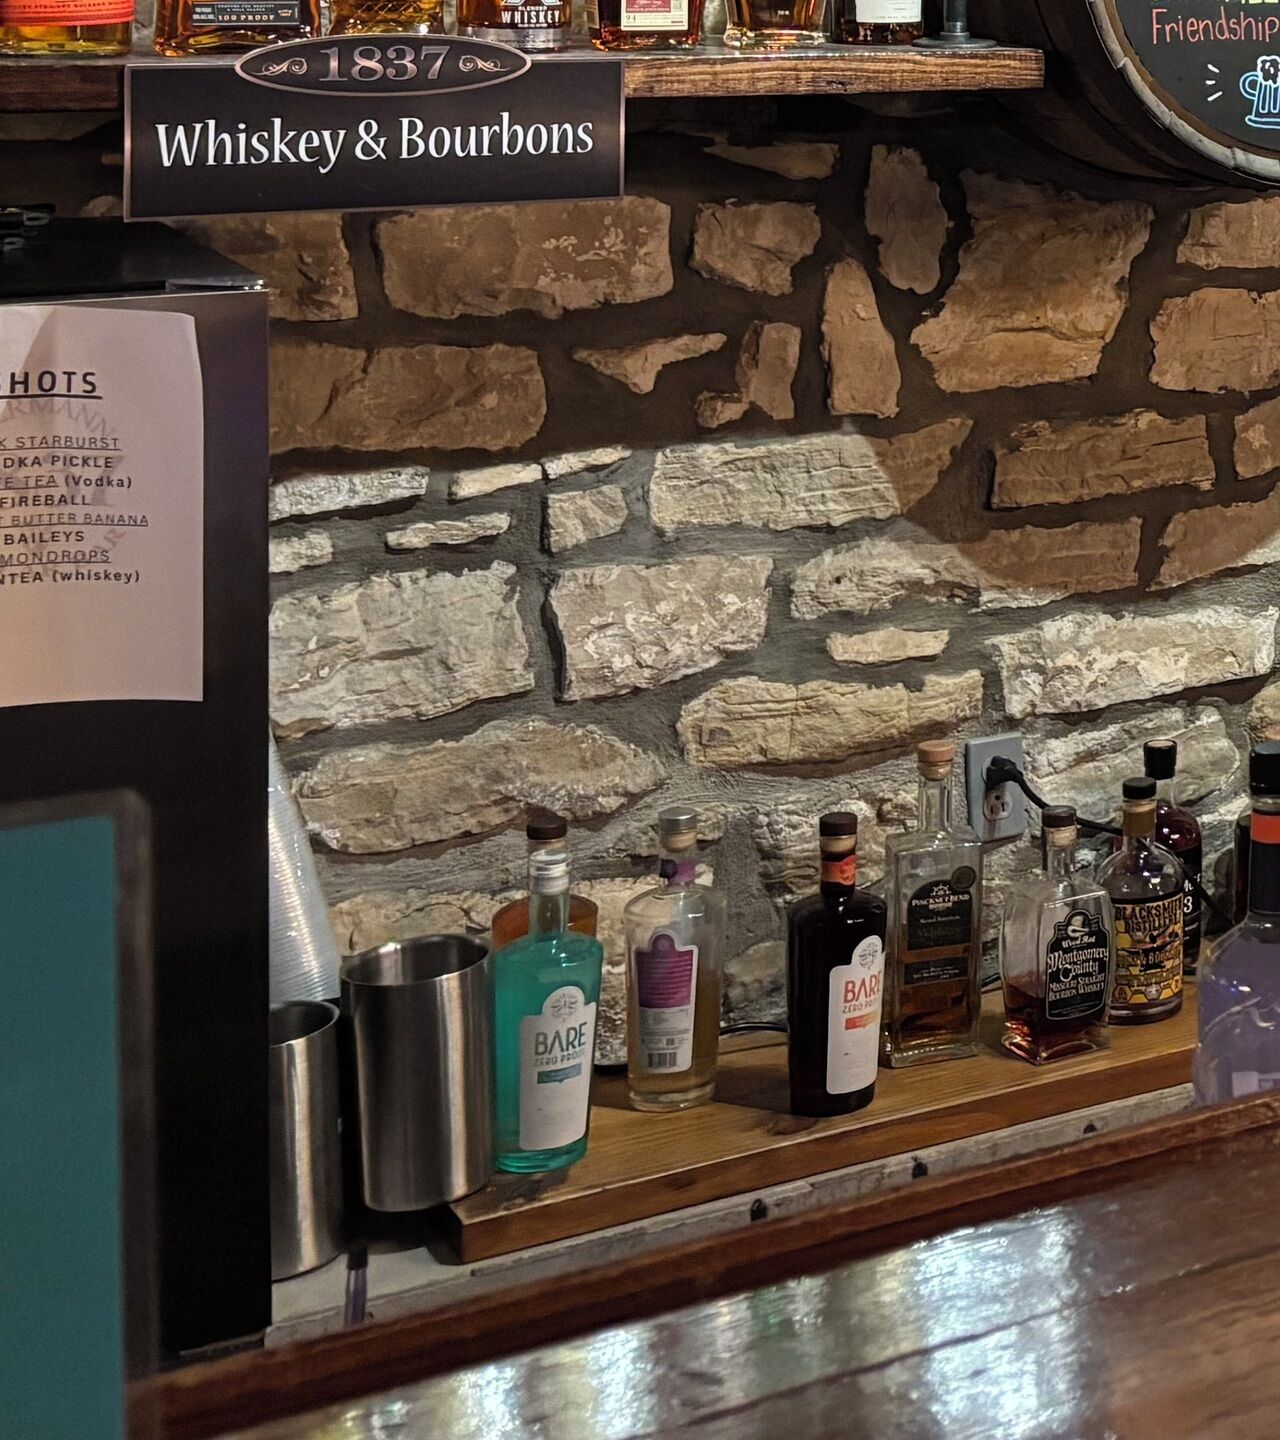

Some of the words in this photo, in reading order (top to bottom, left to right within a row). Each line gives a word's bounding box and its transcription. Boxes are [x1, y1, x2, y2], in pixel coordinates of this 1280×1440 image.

[501, 11, 560, 24] WHISKEY
[1151, 8, 1280, 44] Friendship
[318, 45, 451, 81] 1837
[155, 117, 346, 173] Whiskey
[355, 118, 387, 161] &
[399, 112, 594, 160] Bourbons
[0, 370, 97, 394] HOTS
[15, 435, 120, 449] STARBURST
[51, 455, 114, 468] PICKLE
[65, 476, 132, 489] (Vodka)
[1, 495, 90, 508] FIREBALL
[12, 513, 77, 525] BUTTER
[84, 513, 149, 525] BANANA
[4, 531, 85, 545] BAILEYS
[53, 570, 140, 584] (whiskey)
[1048, 946, 1109, 973] Montgomery
[1060, 960, 1099, 982] County
[535, 1021, 587, 1057] BARE
